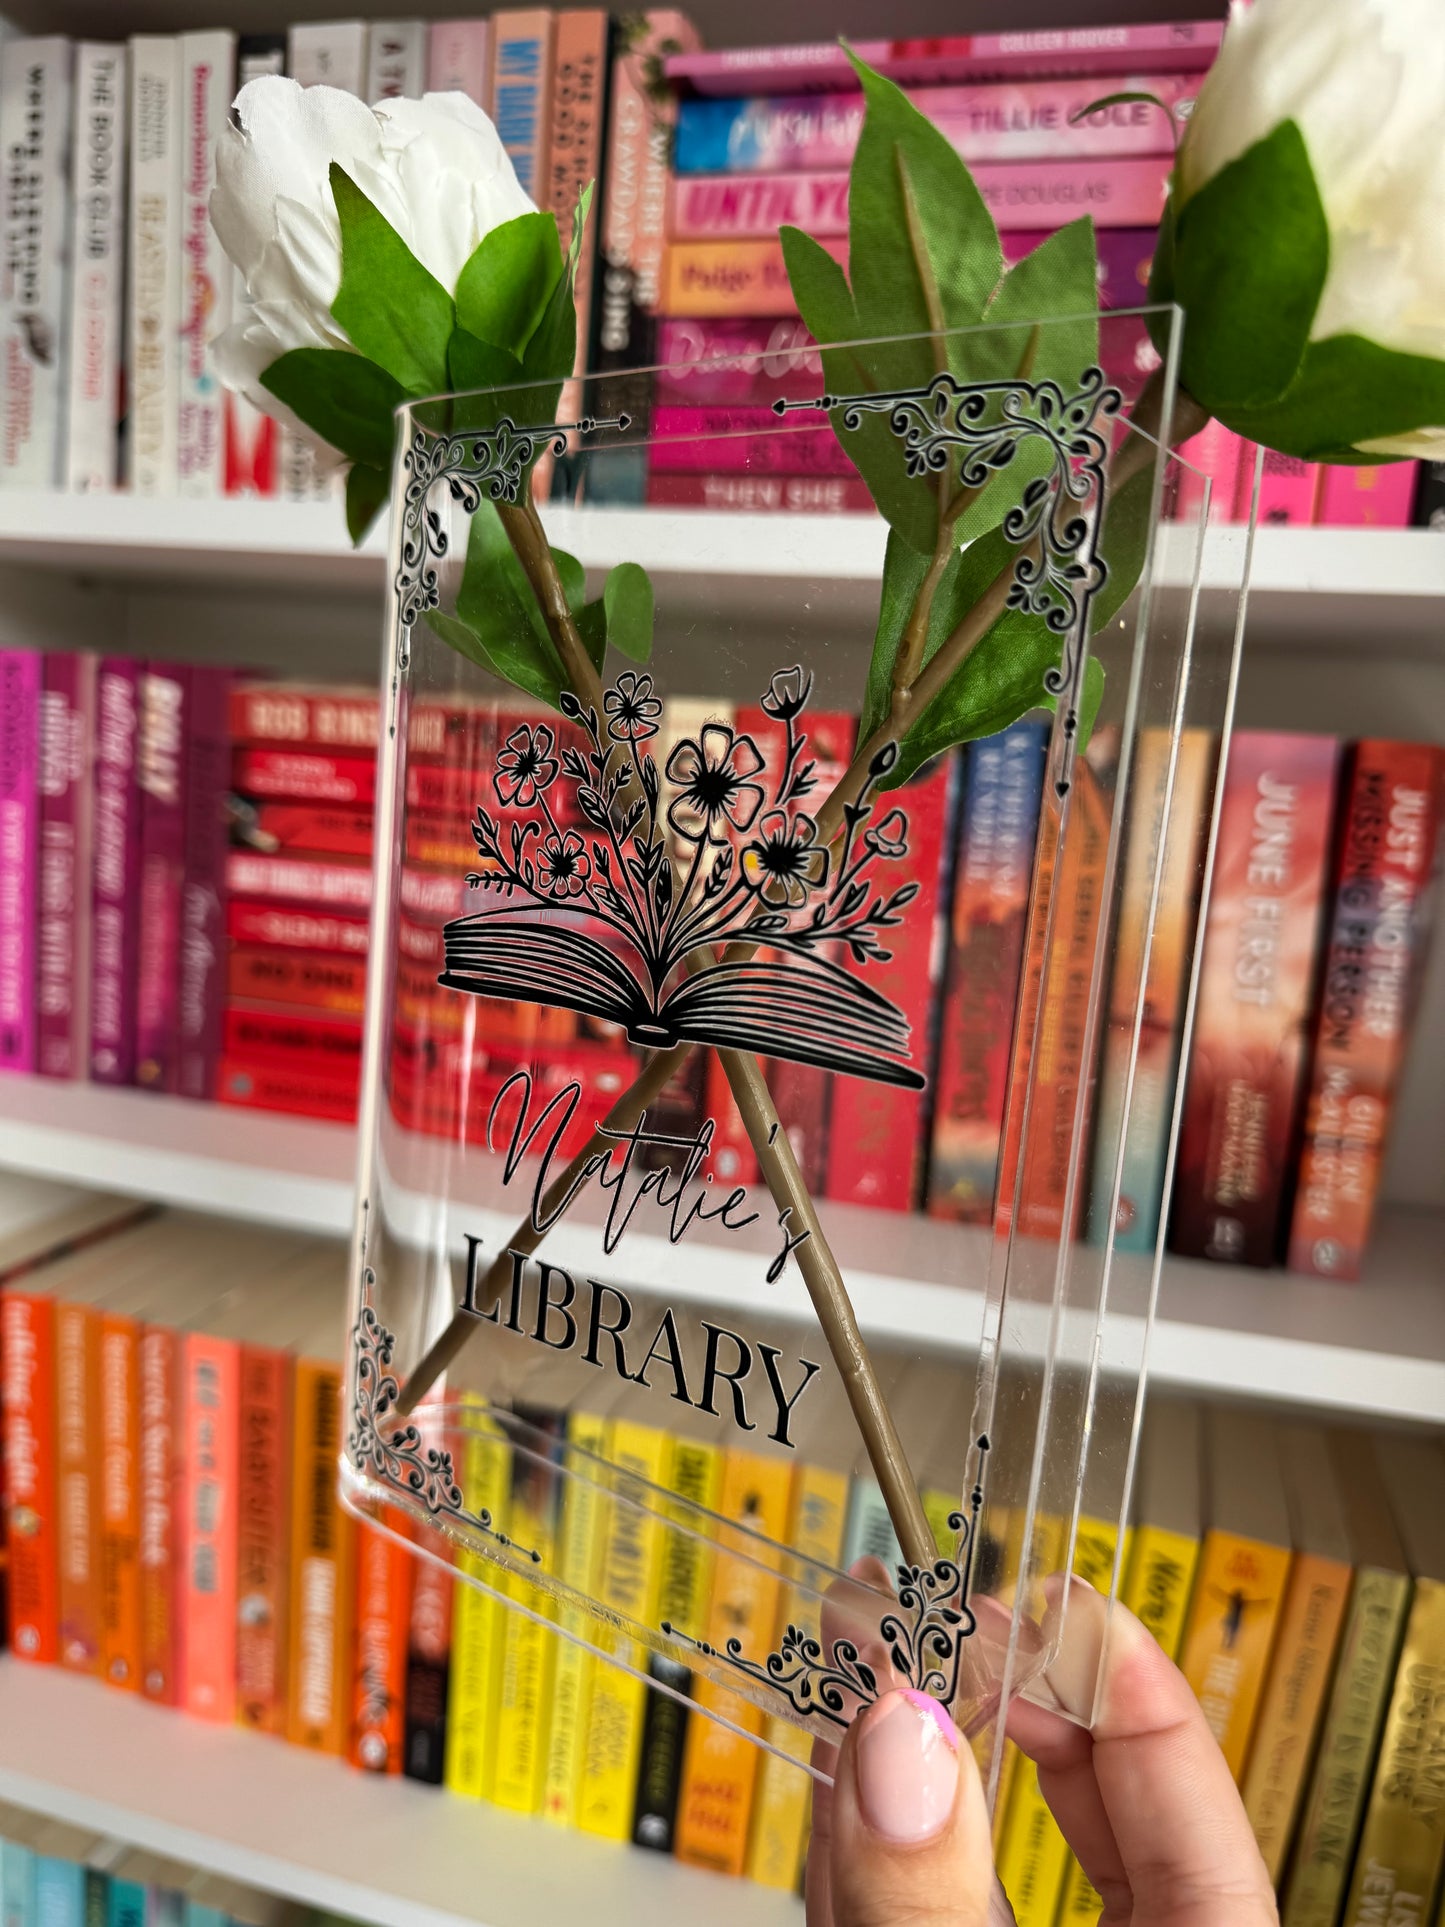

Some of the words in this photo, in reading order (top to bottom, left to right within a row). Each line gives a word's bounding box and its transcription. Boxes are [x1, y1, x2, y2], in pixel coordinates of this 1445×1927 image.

[499, 38, 540, 77] MY
[1000, 31, 1064, 52] COLLEEN
[1067, 27, 1129, 48] HOOVER
[26, 62, 45, 156] WHERE
[90, 59, 117, 107] THE
[556, 63, 578, 149] GOOD
[969, 103, 1058, 132] TILLIE
[1067, 101, 1150, 129] COLE
[87, 111, 114, 189] BOOK
[606, 91, 645, 267] CRAWDADS
[637, 130, 669, 236] WHERE
[1007, 180, 1112, 206] DOUGLAS
[84, 190, 111, 261] CLUB
[600, 267, 634, 351] SING
[633, 250, 663, 306] THE
[1246, 769, 1297, 888] JUNE
[1338, 771, 1385, 908] MISSING
[1383, 784, 1426, 870] JUST
[1233, 895, 1280, 1009] FIRST
[1324, 920, 1375, 1047] PERSON
[1362, 871, 1414, 1039] ANOTHER
[487, 1070, 813, 1285] Natalie's
[458, 1232, 822, 1450] LIBRARY
